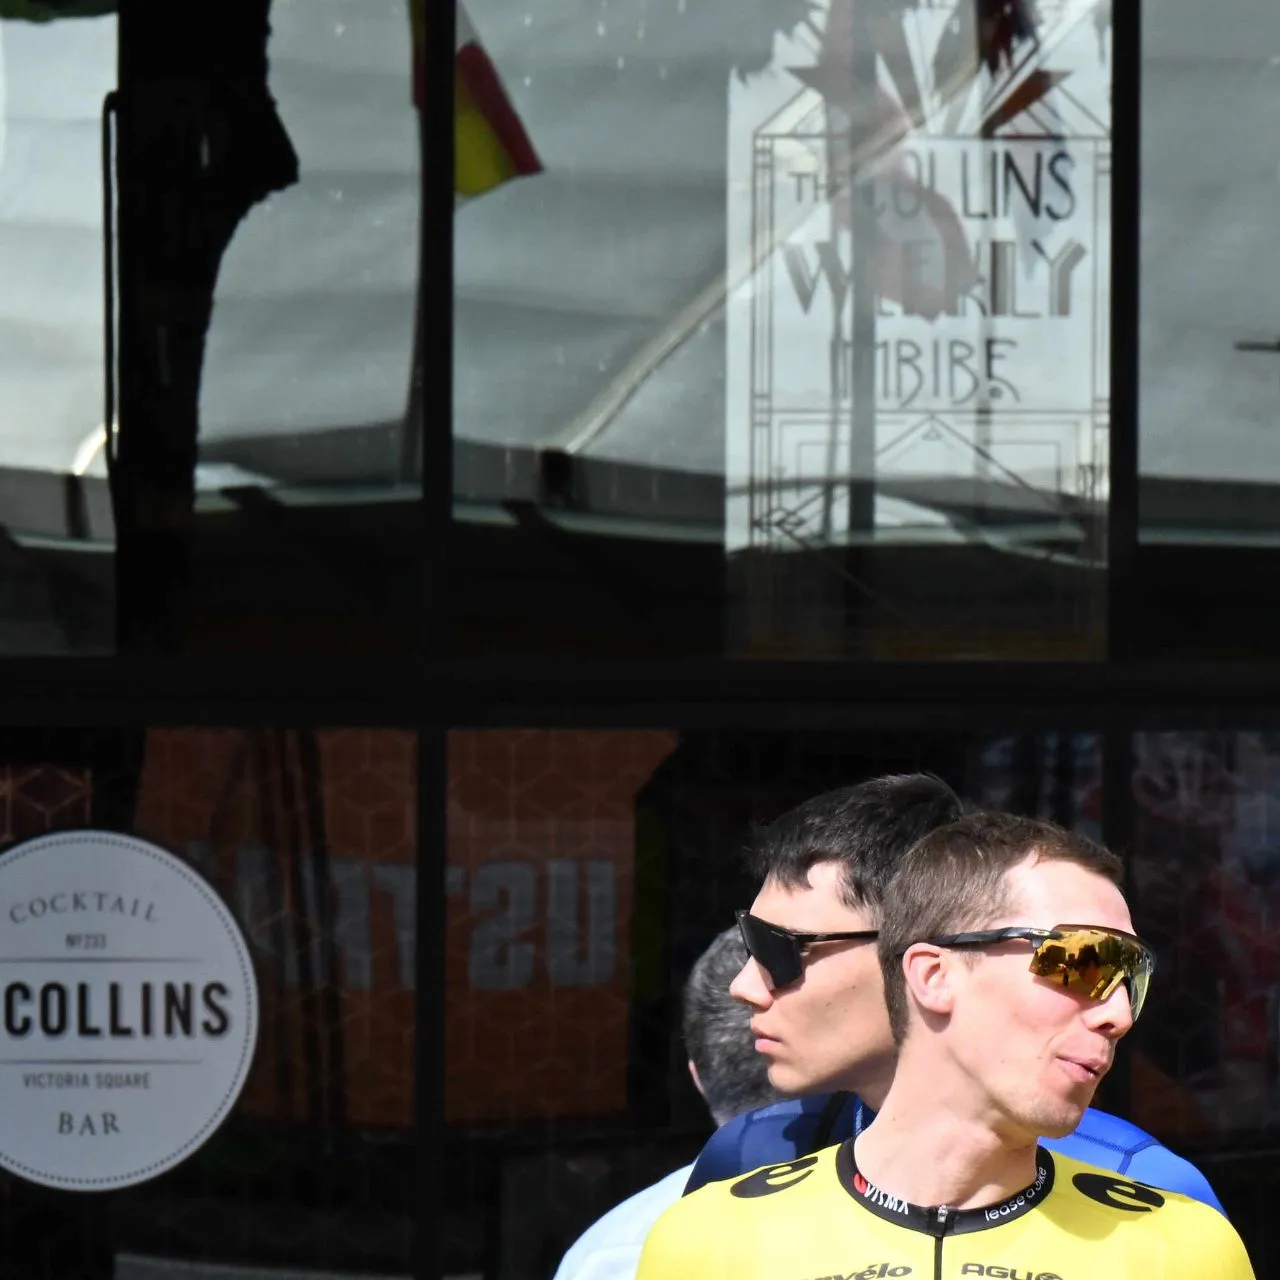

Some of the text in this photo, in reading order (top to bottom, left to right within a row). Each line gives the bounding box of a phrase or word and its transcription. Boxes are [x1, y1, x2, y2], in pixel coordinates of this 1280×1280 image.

[8, 891, 161, 925] COCKTAIL
[3, 980, 232, 1040] COLLINS
[22, 1072, 150, 1091] VICTORIA SQUARE
[58, 1111, 122, 1137] BAR
[984, 1196, 1026, 1222] lease
